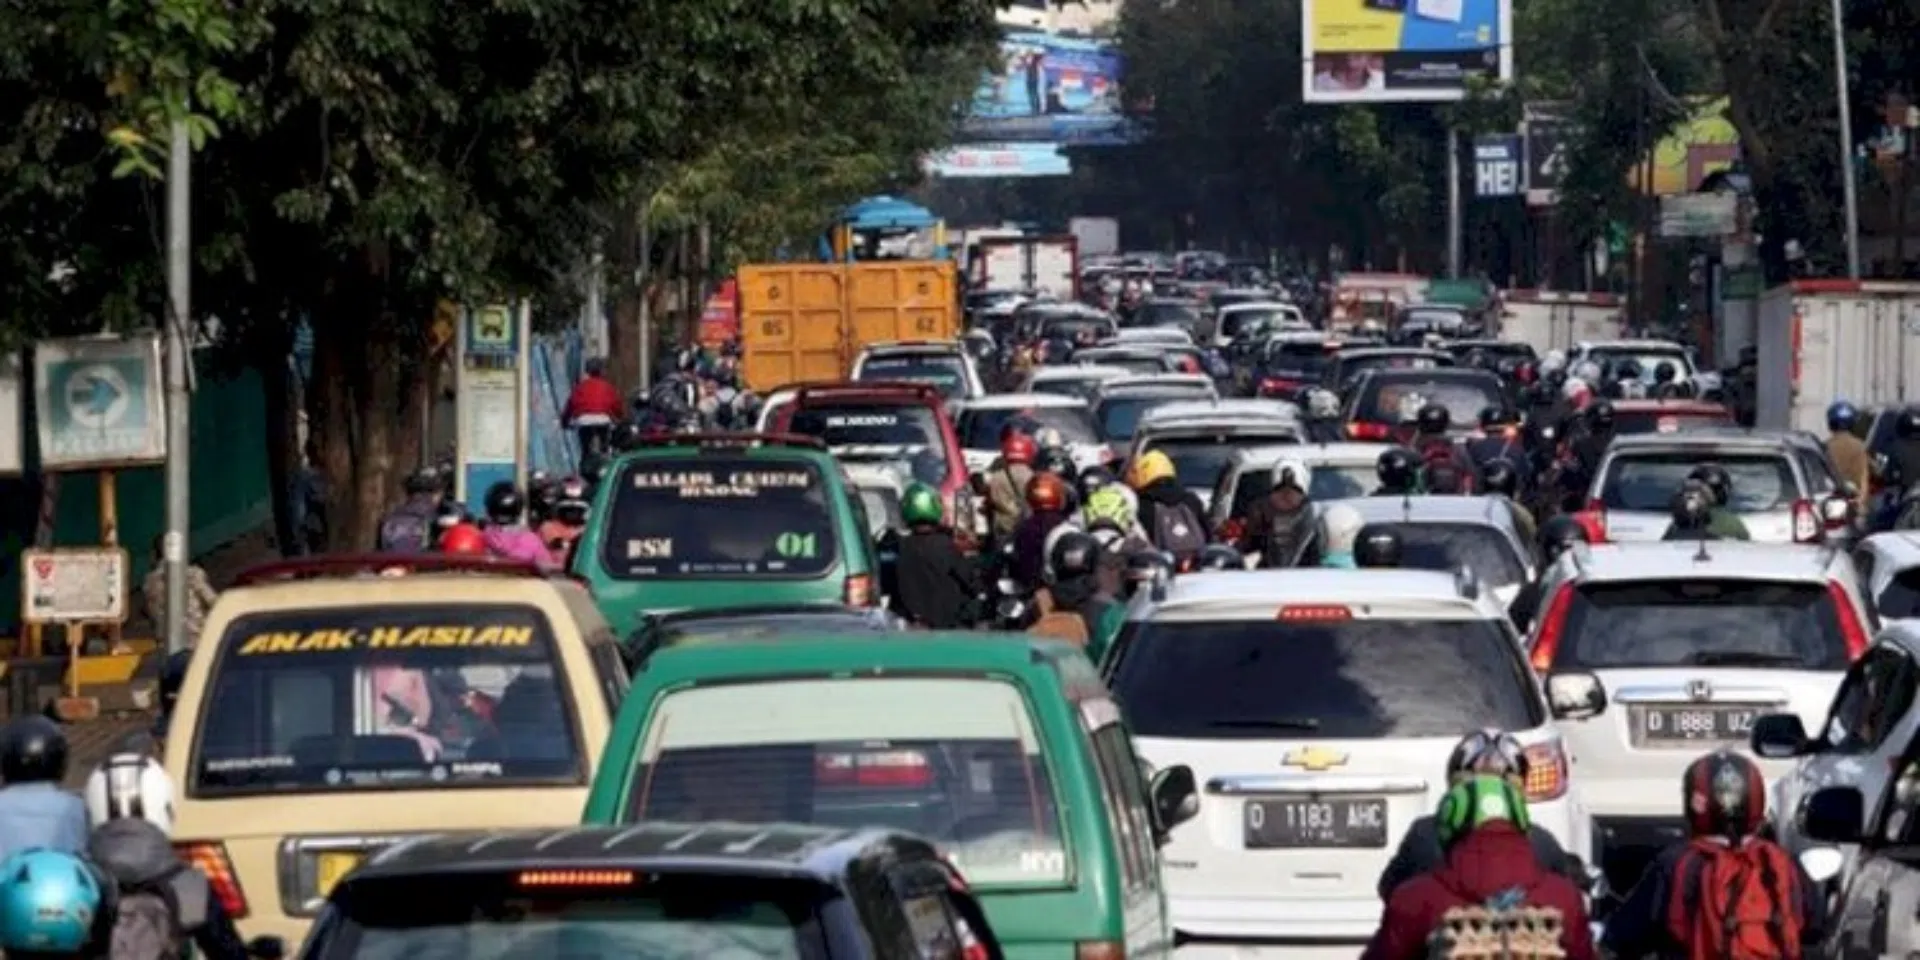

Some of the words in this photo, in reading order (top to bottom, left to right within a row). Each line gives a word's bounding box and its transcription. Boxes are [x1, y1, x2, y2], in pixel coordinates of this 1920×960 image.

[775, 532, 816, 558] 01
[238, 626, 533, 655] ANAK-HASIAN
[1648, 711, 1662, 731] D
[1251, 803, 1264, 829] D
[1286, 803, 1333, 828] 1183
[1347, 803, 1381, 827] AHC
